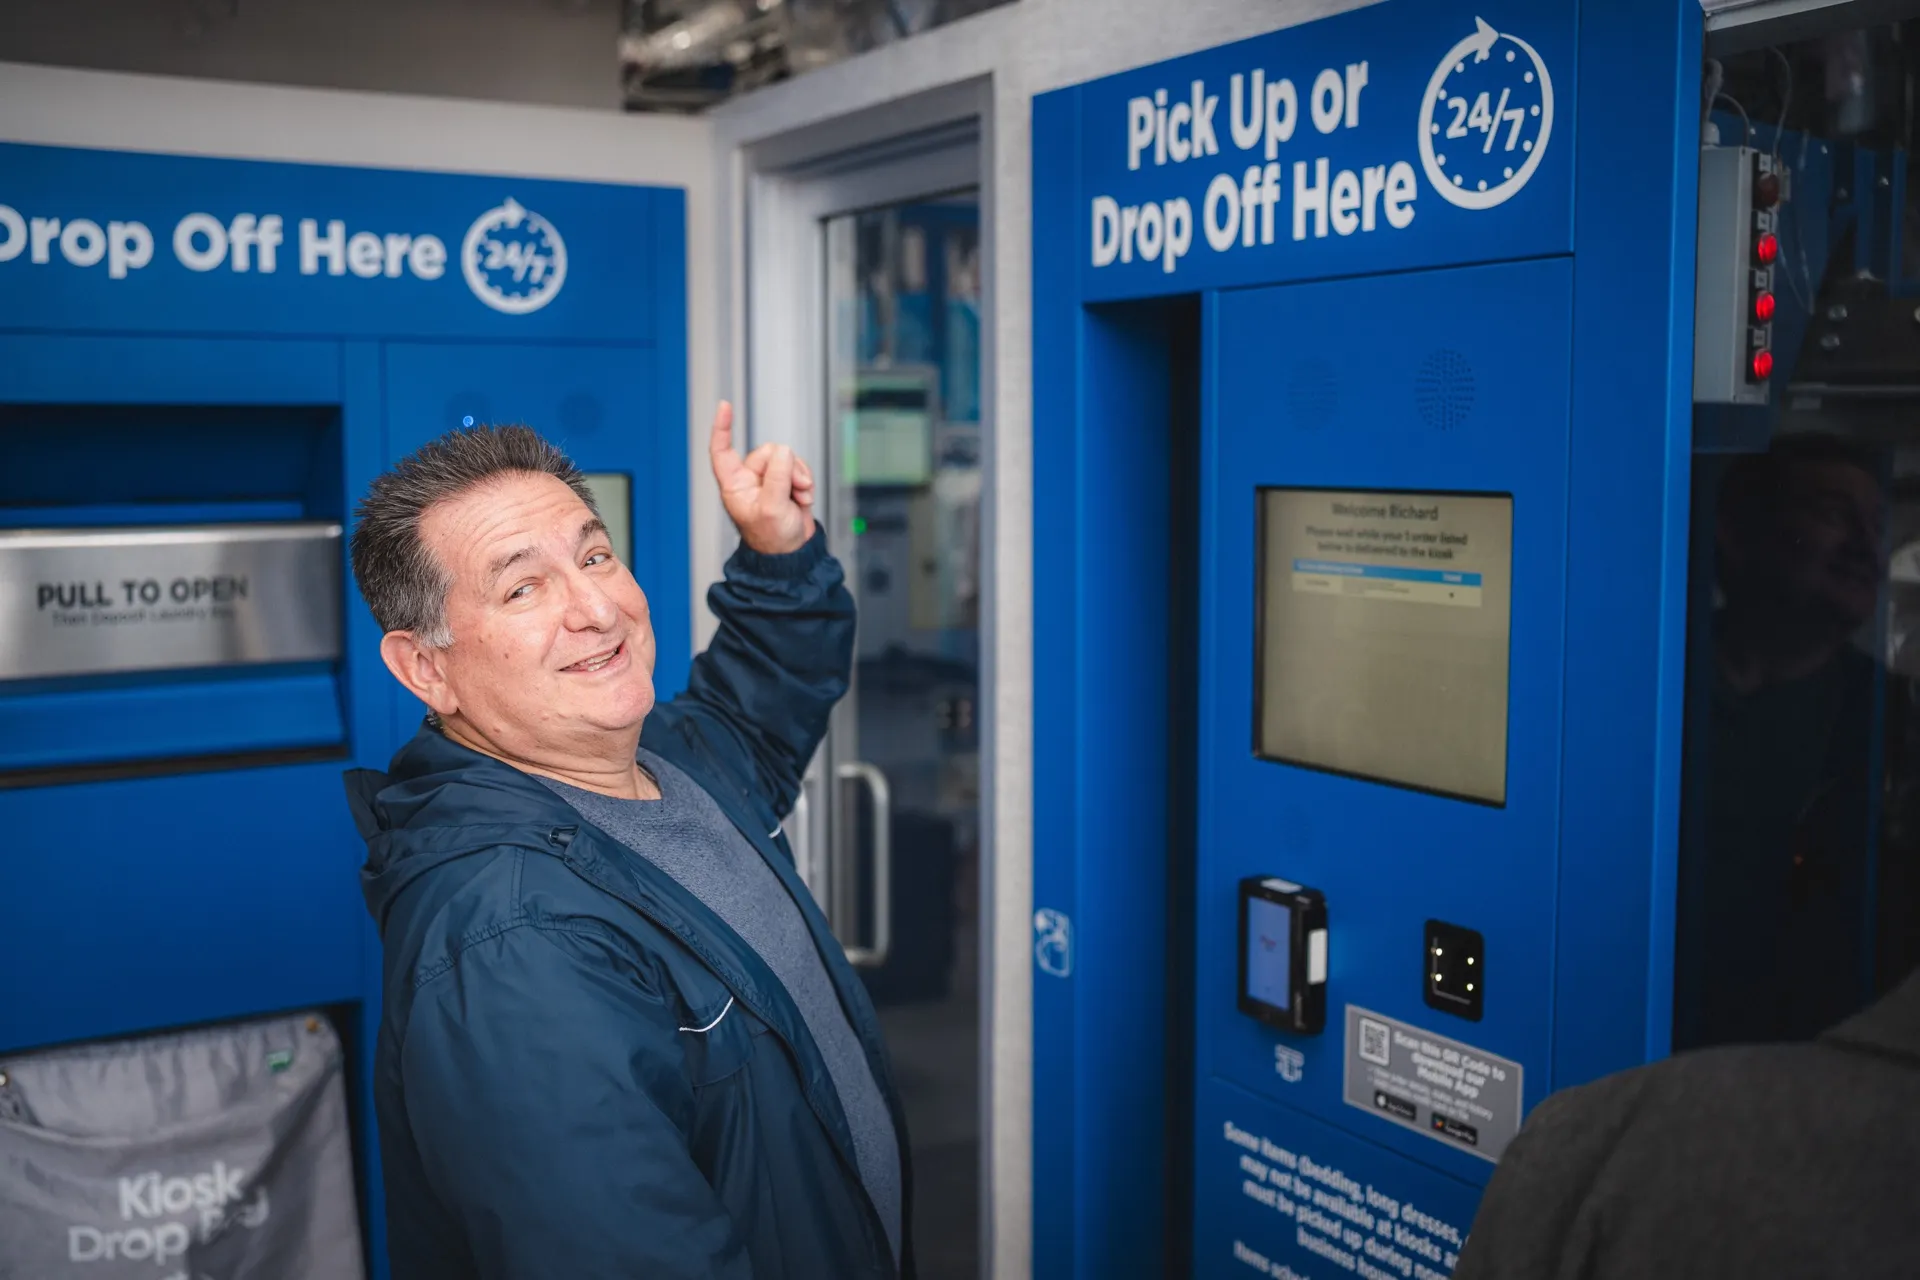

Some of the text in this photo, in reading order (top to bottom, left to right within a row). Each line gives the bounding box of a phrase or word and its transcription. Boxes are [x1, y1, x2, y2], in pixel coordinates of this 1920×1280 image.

[1127, 60, 1370, 171] Pick Up or
[1446, 88, 1527, 154] 24/7
[1091, 157, 1418, 274] Drop Off Here
[172, 212, 284, 274] Off
[299, 218, 447, 281] Here
[484, 239, 548, 284] 24/7
[1389, 503, 1439, 521] Richard
[37, 575, 248, 611] PULL TO OPEN
[117, 1160, 244, 1221] Kiosk
[68, 1222, 190, 1266] Drop
[1394, 1222, 1442, 1263] kiosks
